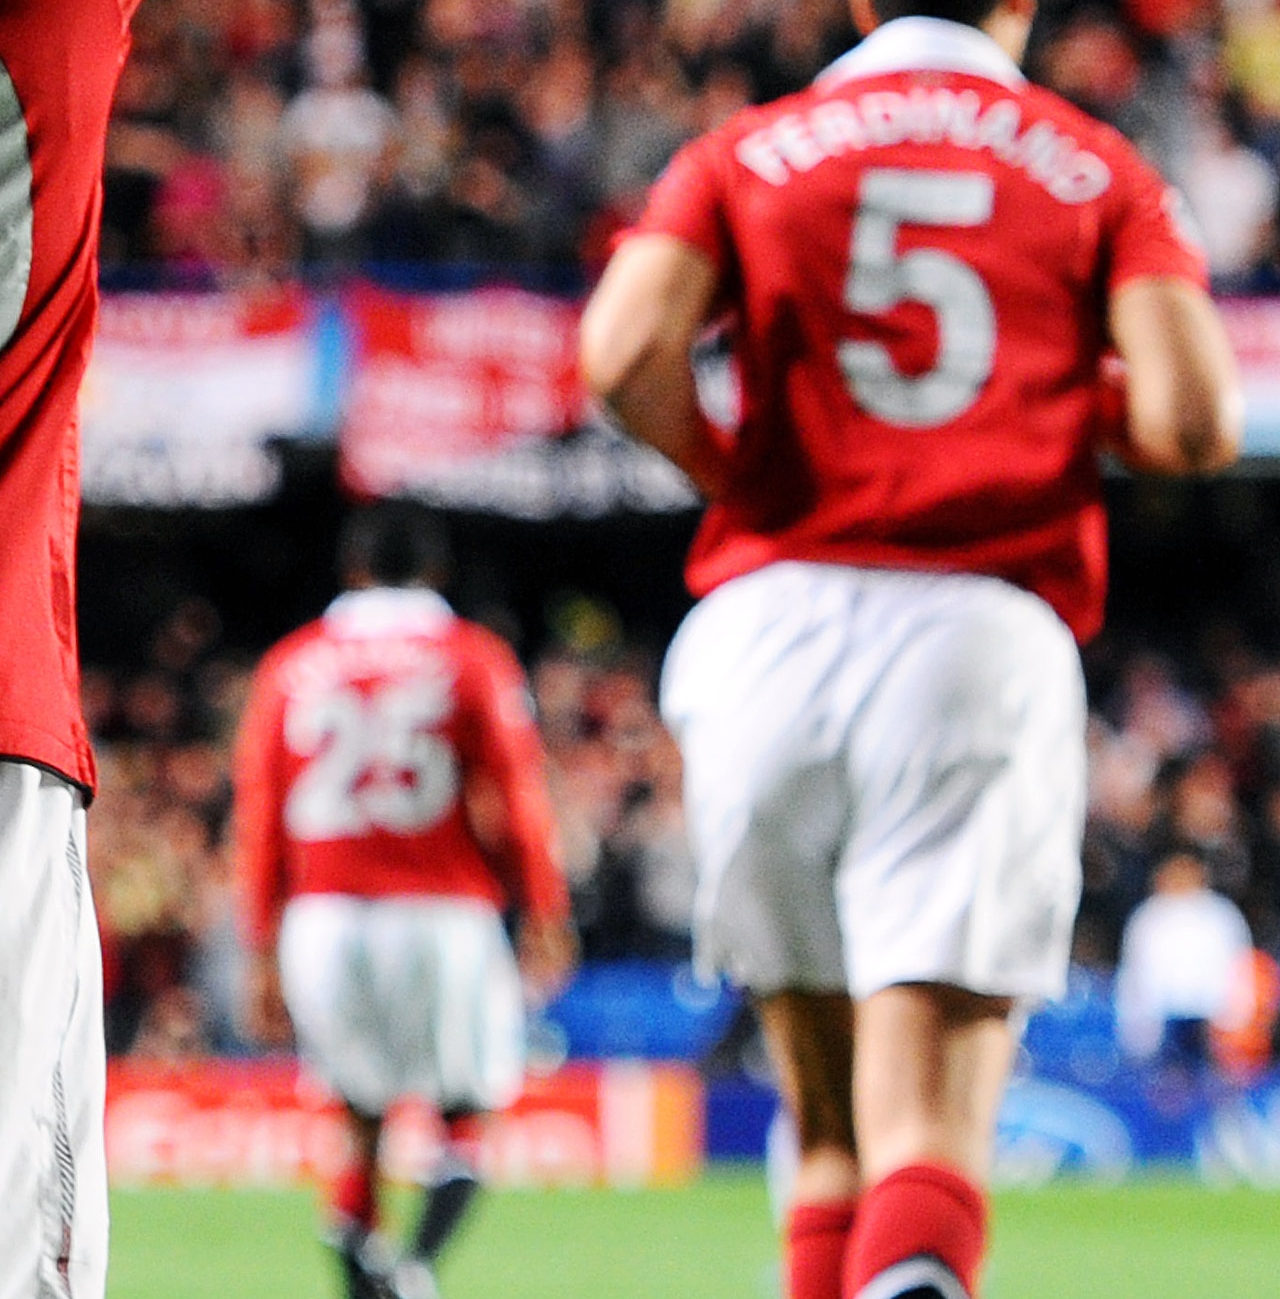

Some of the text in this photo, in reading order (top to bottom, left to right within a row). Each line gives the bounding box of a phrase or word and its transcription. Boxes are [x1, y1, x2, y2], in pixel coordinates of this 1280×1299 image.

[736, 88, 1113, 203] FERDINAND
[835, 167, 998, 430] 5
[284, 678, 460, 842] 25
